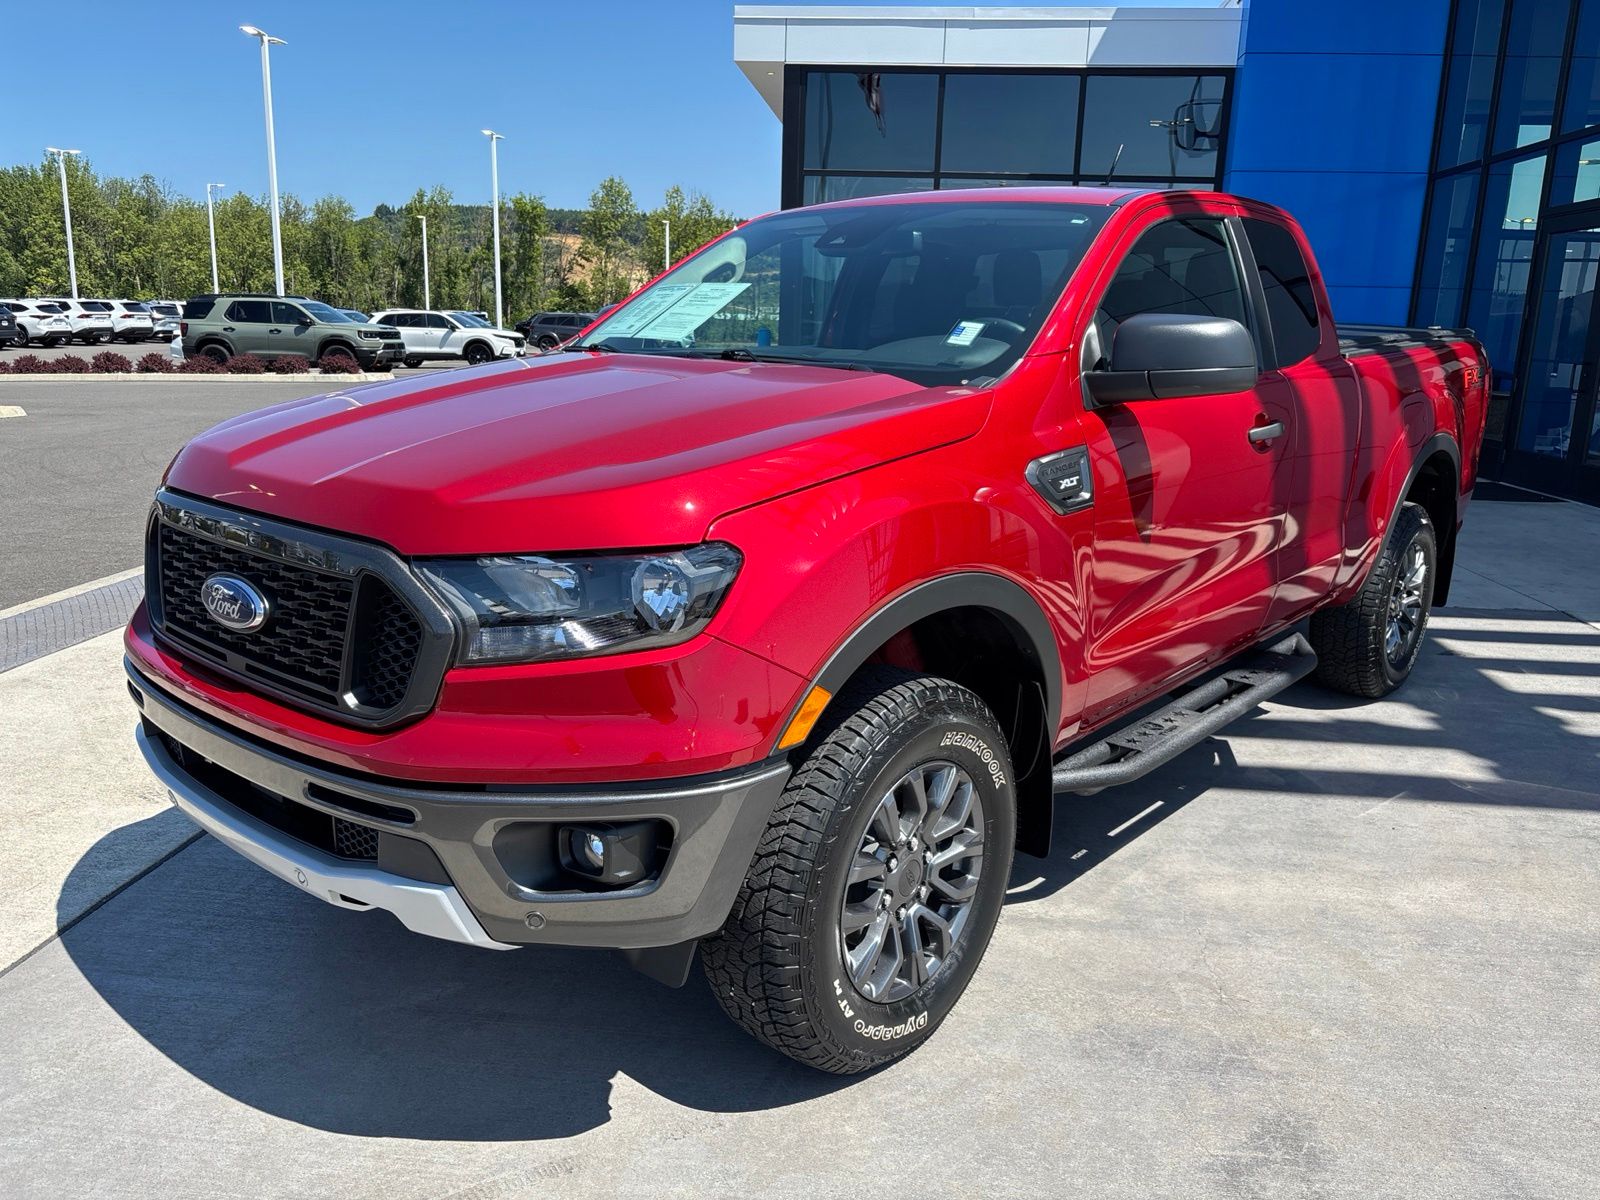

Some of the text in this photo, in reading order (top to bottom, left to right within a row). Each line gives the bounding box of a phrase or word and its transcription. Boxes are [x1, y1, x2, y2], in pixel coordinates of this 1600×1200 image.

[1059, 475, 1080, 490] XLT
[208, 584, 240, 619] Ford
[836, 998, 855, 1019] AT
[854, 1010, 928, 1041] Dynapro
